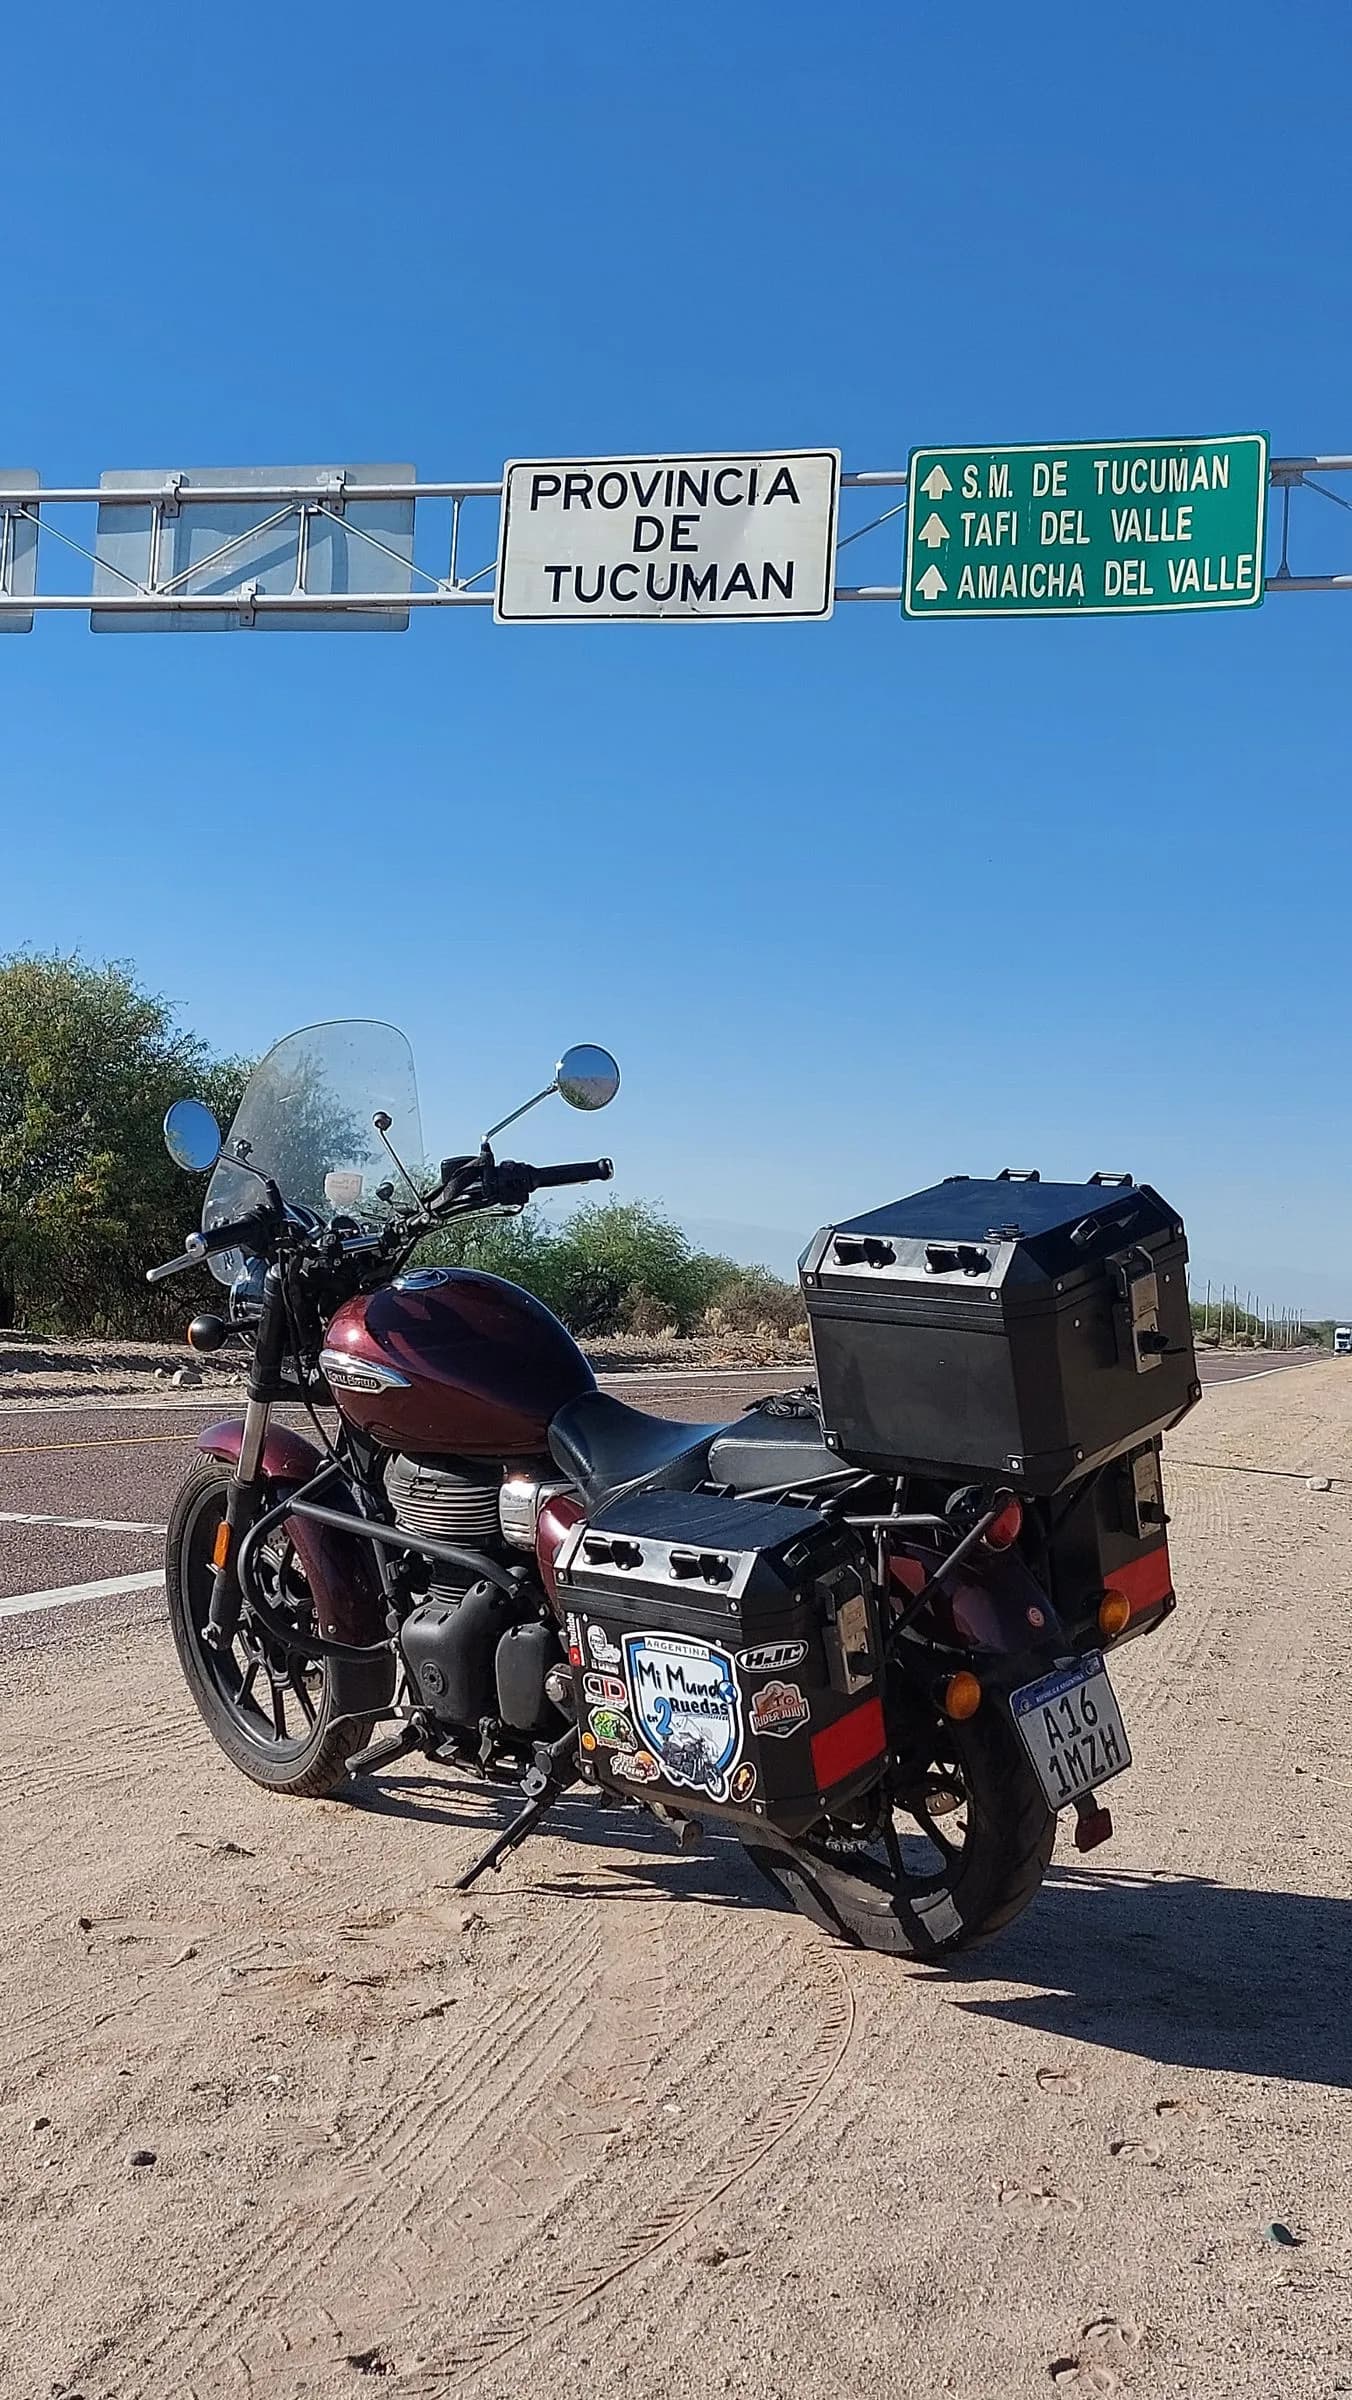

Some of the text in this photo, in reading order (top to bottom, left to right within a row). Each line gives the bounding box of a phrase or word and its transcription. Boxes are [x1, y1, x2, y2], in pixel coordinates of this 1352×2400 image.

[530, 467, 800, 511] PROVINCIA
[1032, 461, 1068, 497] DE
[1094, 455, 1230, 495] TUCUMAN
[633, 514, 700, 552] DE
[960, 506, 1193, 547] TAFI DEL VALLE
[544, 561, 795, 603] TUCUMAN
[957, 554, 1253, 600] AMAICHA DEL VALLE
[646, 1639, 708, 1657] ARGENTINA
[744, 1645, 802, 1668] HJC
[637, 1659, 662, 1691] Mi
[654, 1696, 673, 1735] 2
[670, 1697, 729, 1715] Ruedas
[1042, 1685, 1098, 1750] A16
[1048, 1724, 1122, 1798] 1MZH
